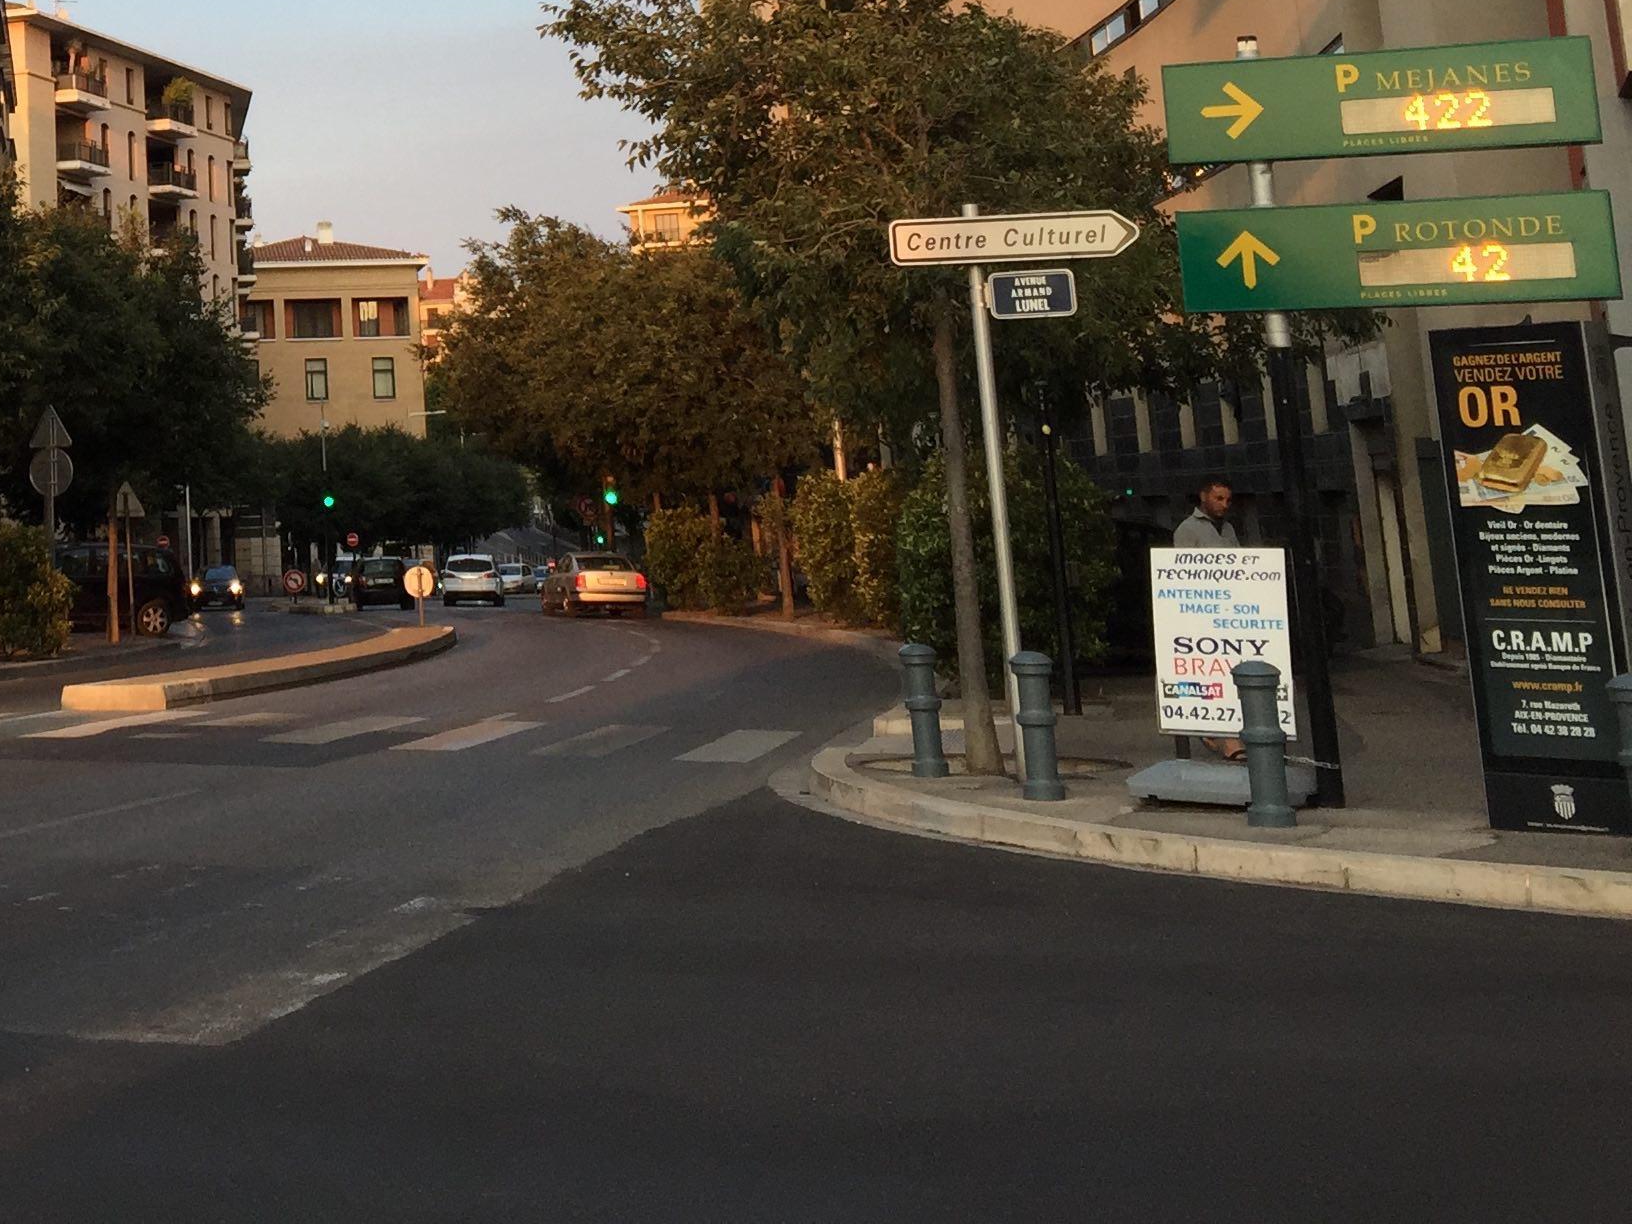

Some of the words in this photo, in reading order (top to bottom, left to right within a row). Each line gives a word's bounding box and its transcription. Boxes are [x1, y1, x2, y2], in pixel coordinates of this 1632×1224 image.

[1335, 64, 1360, 92] P
[1376, 62, 1532, 93] MEJANES
[1403, 88, 1494, 131] 422
[907, 233, 987, 251] Centre
[1003, 224, 1106, 247] Culturel
[1352, 214, 1376, 244] P
[1395, 215, 1564, 243] ROTONDE
[1450, 243, 1512, 283] 42
[1015, 299, 1050, 312] LUNEL
[1453, 355, 1496, 366] GAGNEZ
[1498, 354, 1510, 364] DE
[1512, 352, 1562, 364] L'ARGENT
[1454, 367, 1513, 383] VENDEZ
[1516, 365, 1564, 380] VOTRE
[1458, 386, 1521, 427] OR
[1174, 553, 1237, 565] IMAGES
[1157, 589, 1232, 600] ANTENNES
[1179, 604, 1220, 614] IMAGE
[1233, 604, 1260, 614] SON
[1213, 619, 1284, 630] SECURITE
[1173, 636, 1270, 656] SONY
[1492, 629, 1593, 653] C.R.A.M.P
[1164, 683, 1222, 698] CANALSAT
[1512, 681, 1582, 693] www.cramp.fr
